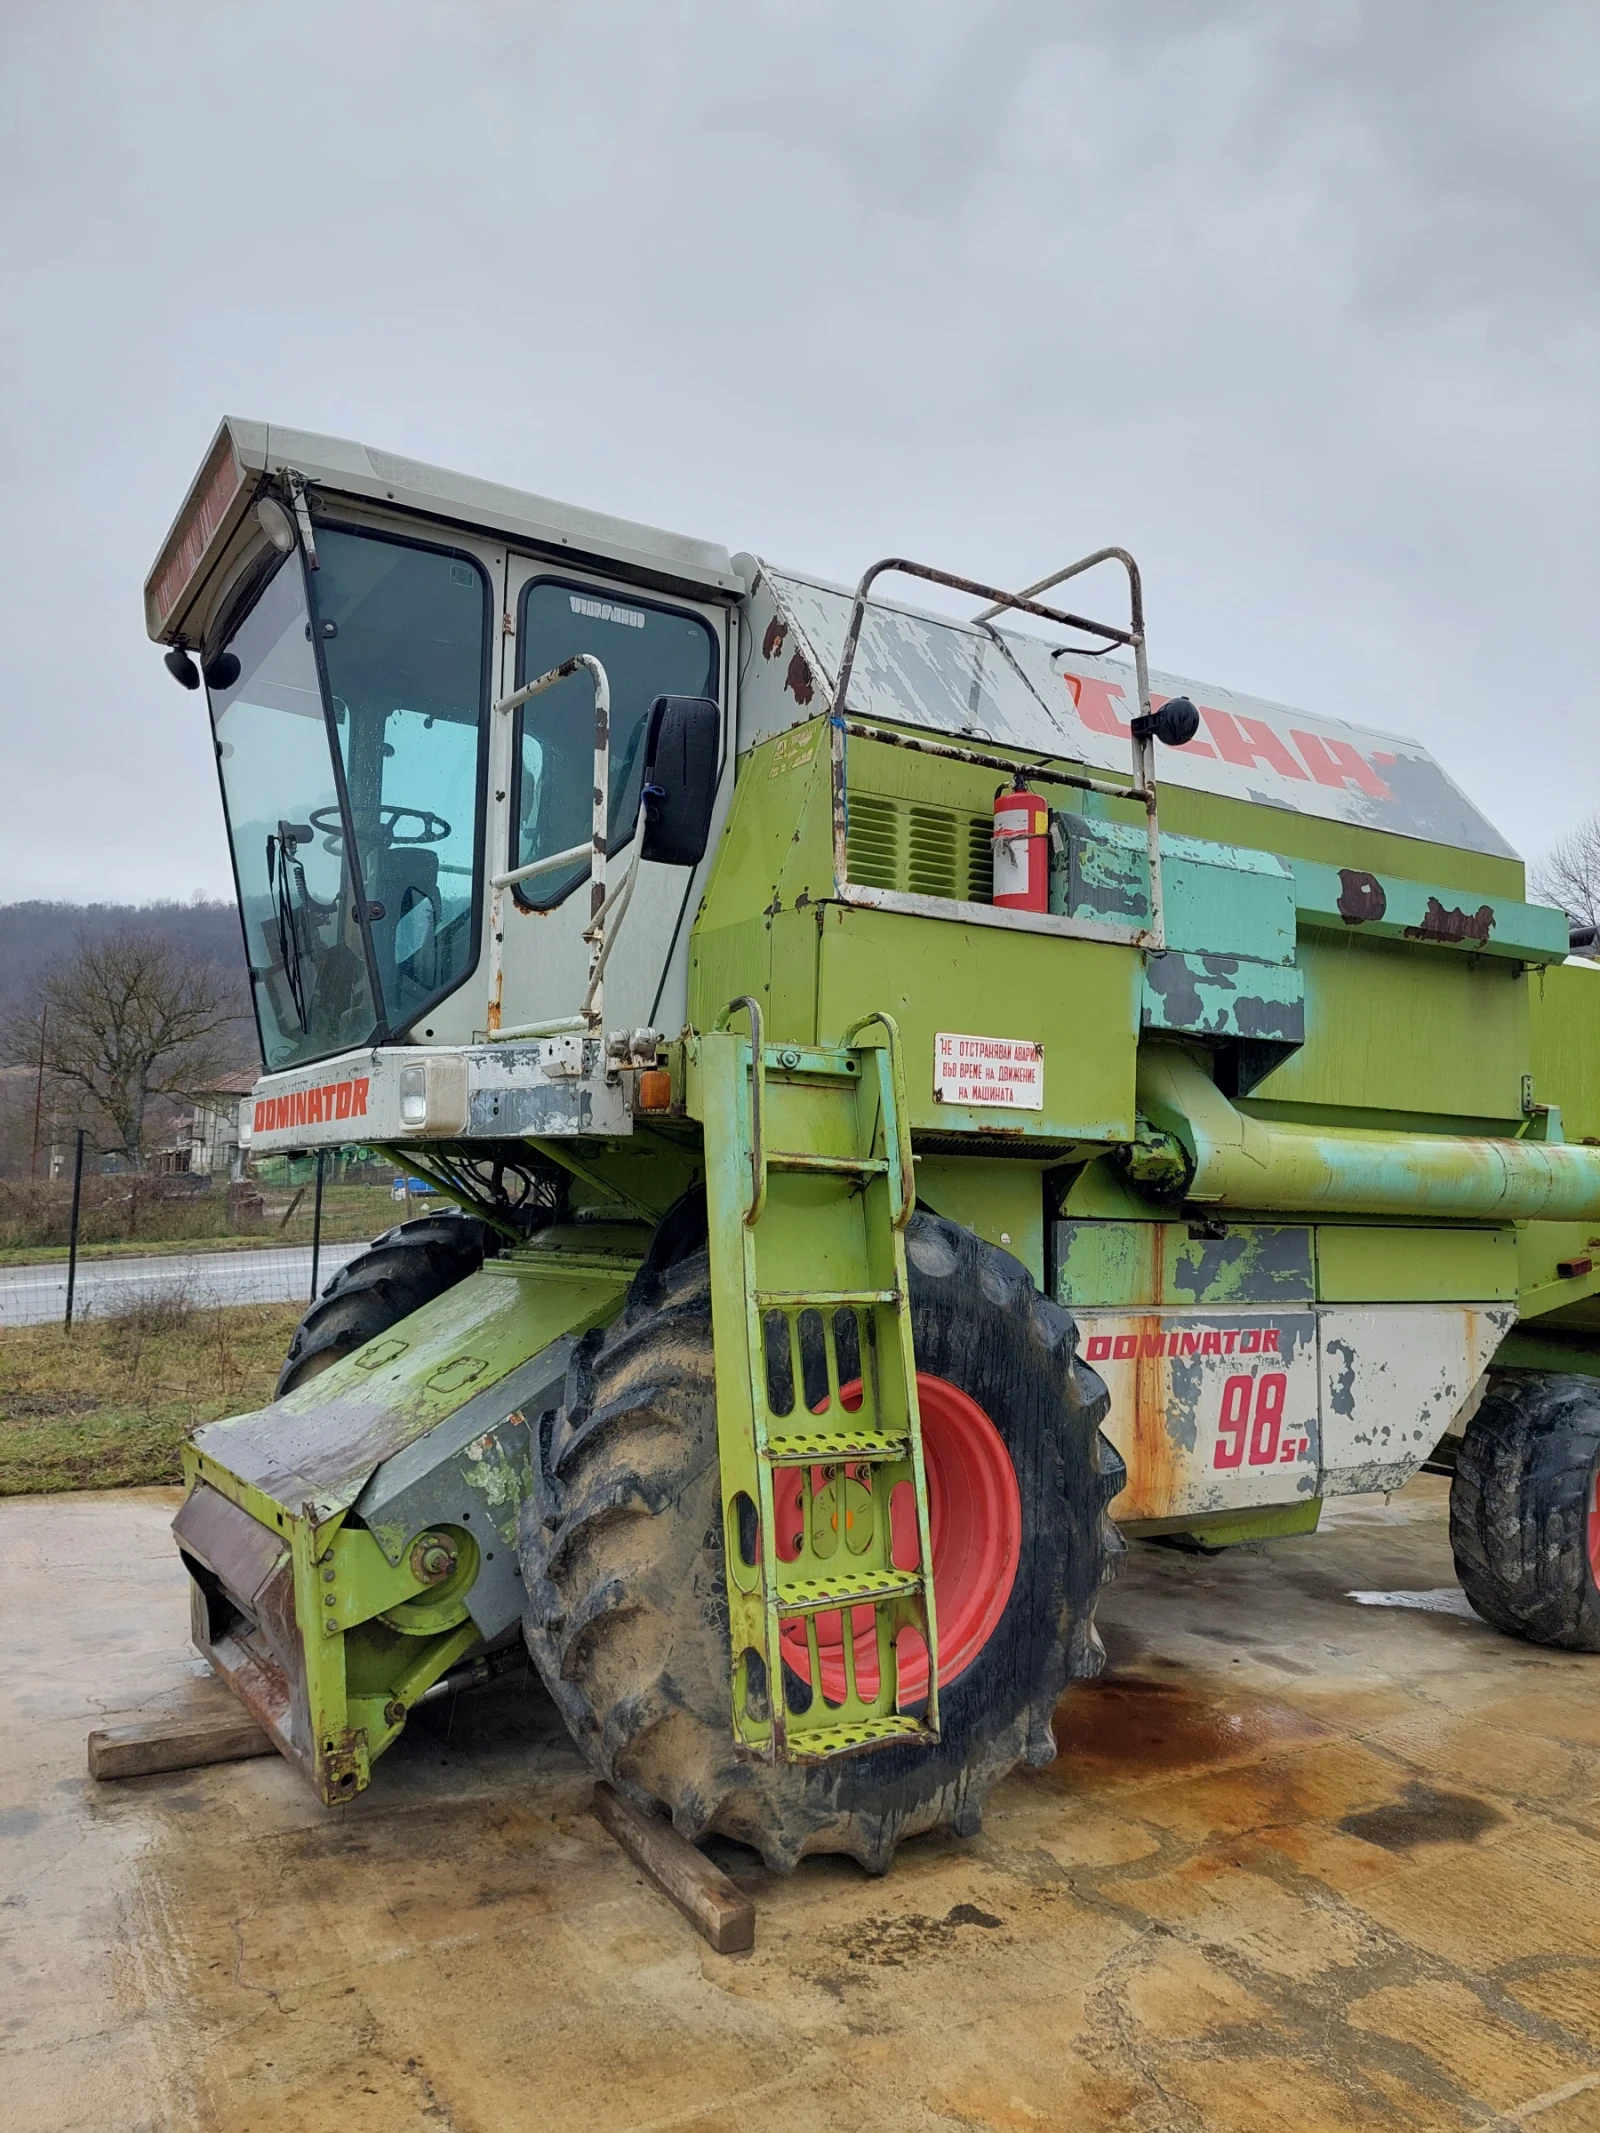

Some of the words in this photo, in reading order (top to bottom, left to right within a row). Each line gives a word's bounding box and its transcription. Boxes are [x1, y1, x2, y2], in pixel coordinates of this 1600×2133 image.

[1064, 672, 1397, 801] CAA
[941, 1039, 953, 1056] НЕ
[959, 1062, 983, 1080] ВРЕМЕ
[998, 1065, 1036, 1084] ДВИЖЕНИЕ
[253, 1077, 370, 1133] DOMINATOR
[958, 1085, 969, 1099] НА
[971, 1084, 1014, 1103] МАШИНАТА
[1086, 1329, 1281, 1361] DOMINATOR
